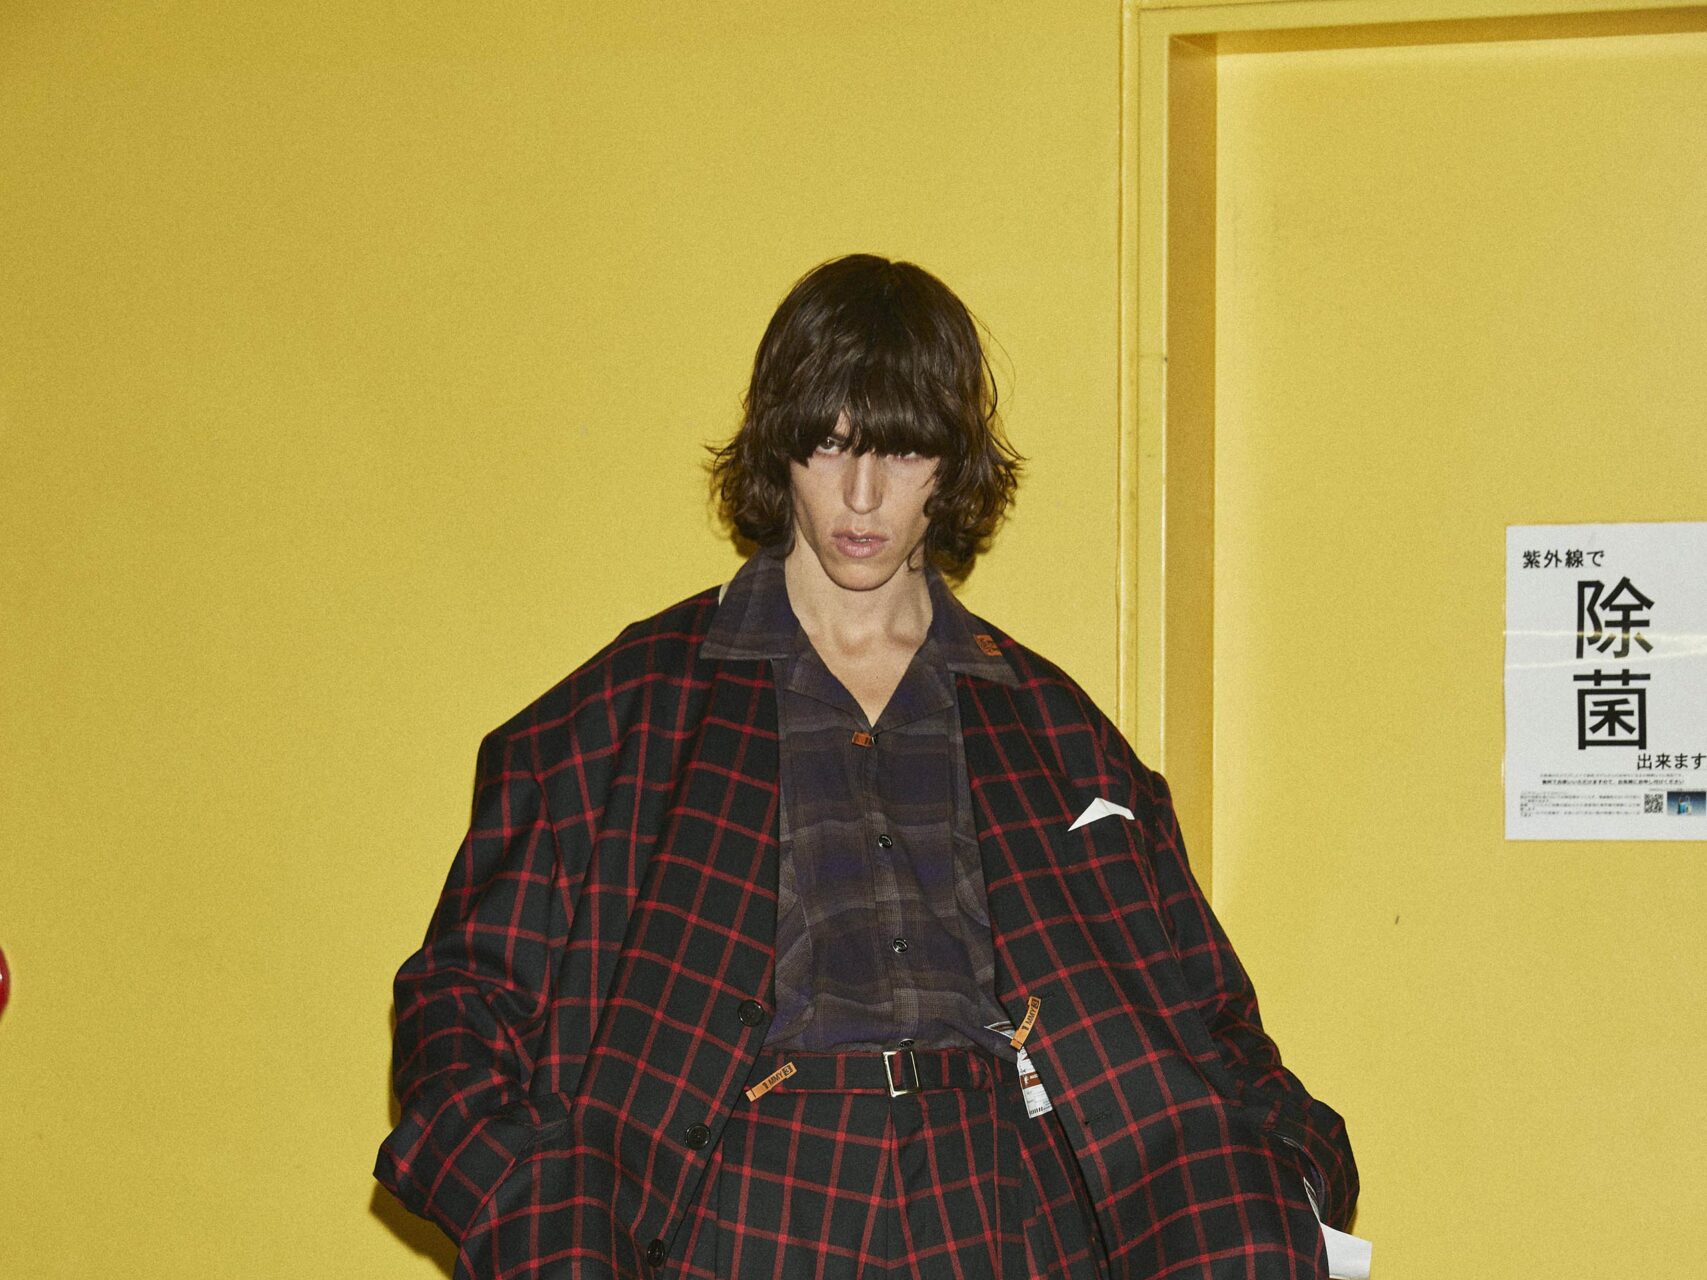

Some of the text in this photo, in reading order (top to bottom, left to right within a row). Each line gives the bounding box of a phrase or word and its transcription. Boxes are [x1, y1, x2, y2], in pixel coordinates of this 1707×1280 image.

[1522, 549, 1604, 568] 紫外線で
[1573, 576, 1655, 750] 除菌
[1637, 752, 1706, 770] 出来ます
